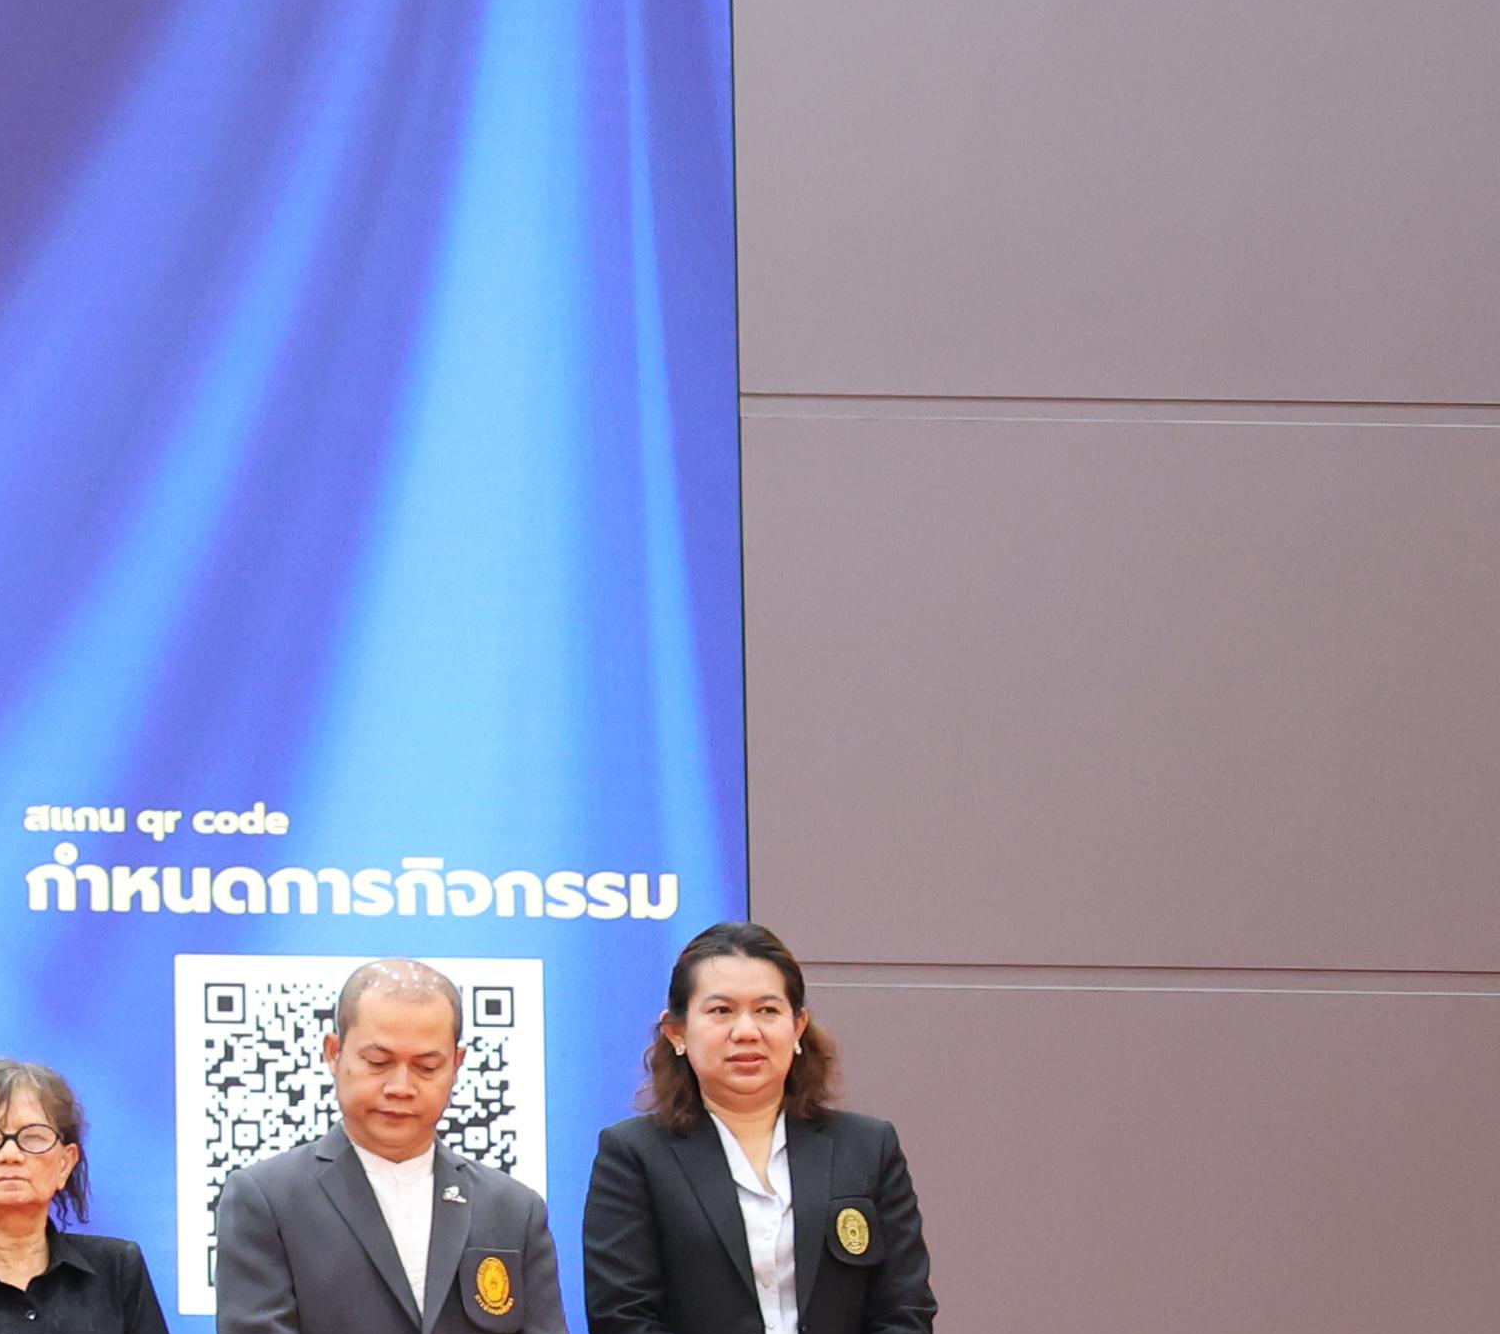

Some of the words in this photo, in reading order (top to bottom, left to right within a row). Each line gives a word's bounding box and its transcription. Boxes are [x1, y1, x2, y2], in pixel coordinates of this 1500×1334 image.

[23, 805, 126, 833] สแกน
[136, 809, 183, 842] qr
[192, 802, 290, 836] code
[25, 842, 679, 921] กำหนดการกิจกรรม
